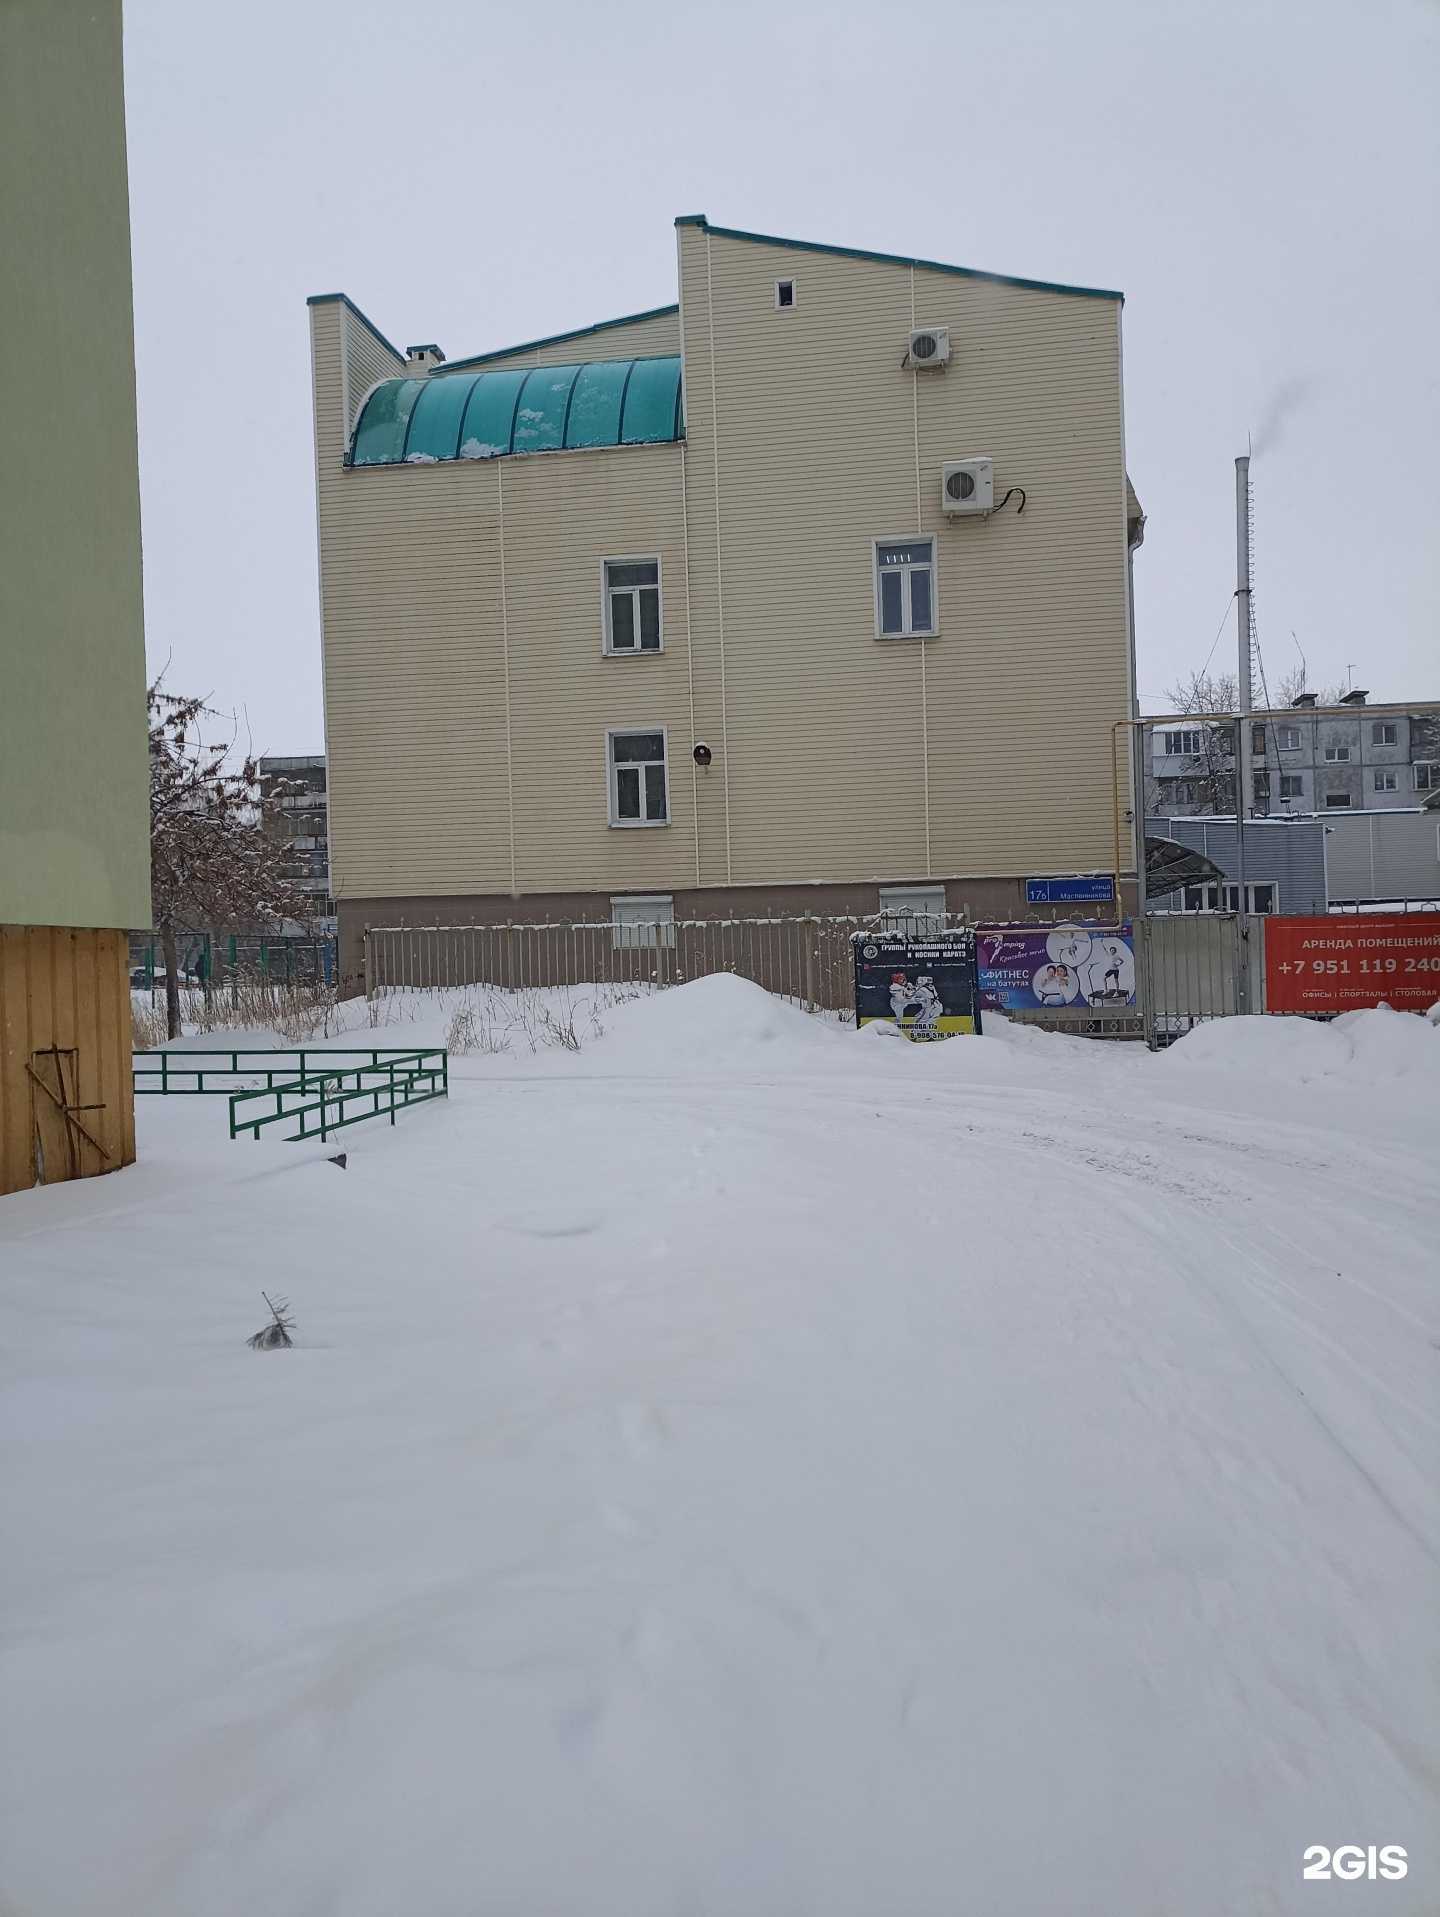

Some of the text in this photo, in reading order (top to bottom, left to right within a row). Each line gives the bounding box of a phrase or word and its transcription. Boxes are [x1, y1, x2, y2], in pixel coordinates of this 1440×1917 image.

[1302, 934, 1440, 950] АРЕНДА ПОМЕЩЕНИЙ
[1278, 960, 1306, 975] +7
[1312, 959, 1351, 975] 951
[1359, 958, 1397, 974] 119
[986, 969, 1030, 979] ФИТНЕС
[1302, 989, 1437, 999] ОФИСЫ СПОРТЗАЛЫ СТОЛОВАЯ
